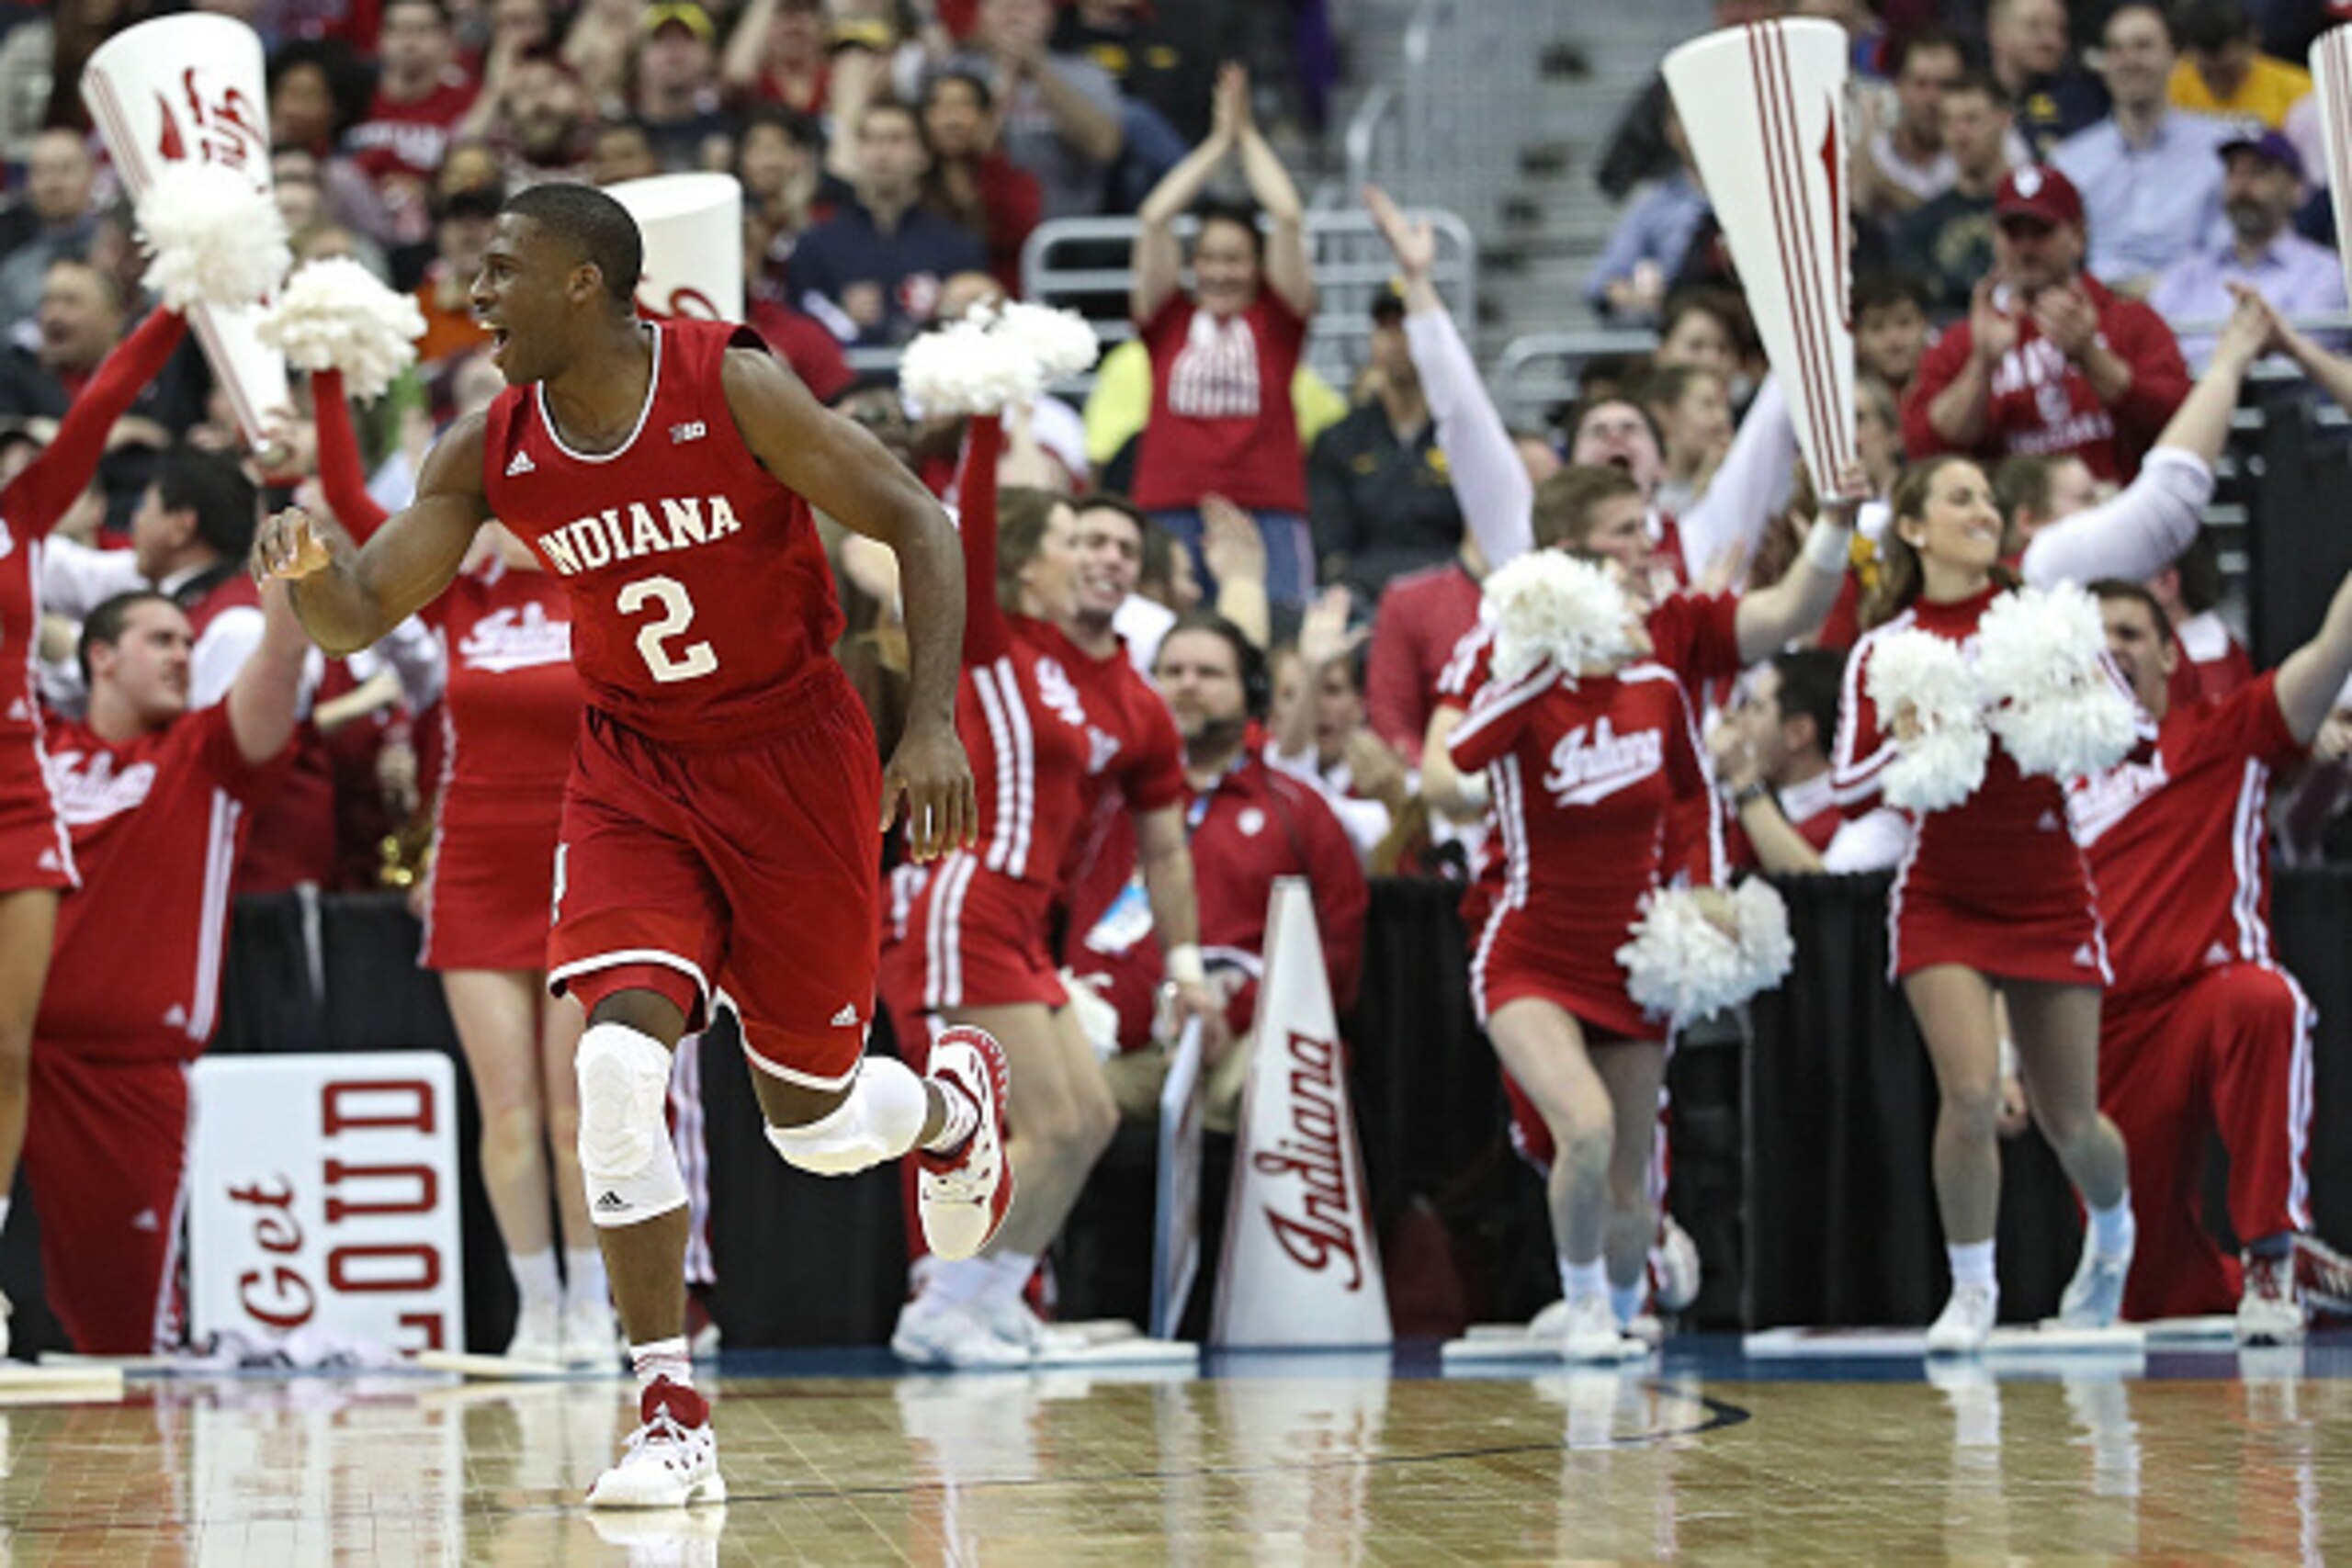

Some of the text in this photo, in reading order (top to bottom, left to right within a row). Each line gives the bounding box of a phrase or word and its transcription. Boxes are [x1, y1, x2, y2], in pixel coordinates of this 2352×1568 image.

[616, 574, 718, 682] 2
[1255, 1030, 1363, 1292] Indiana
[228, 1172, 316, 1328] Get
